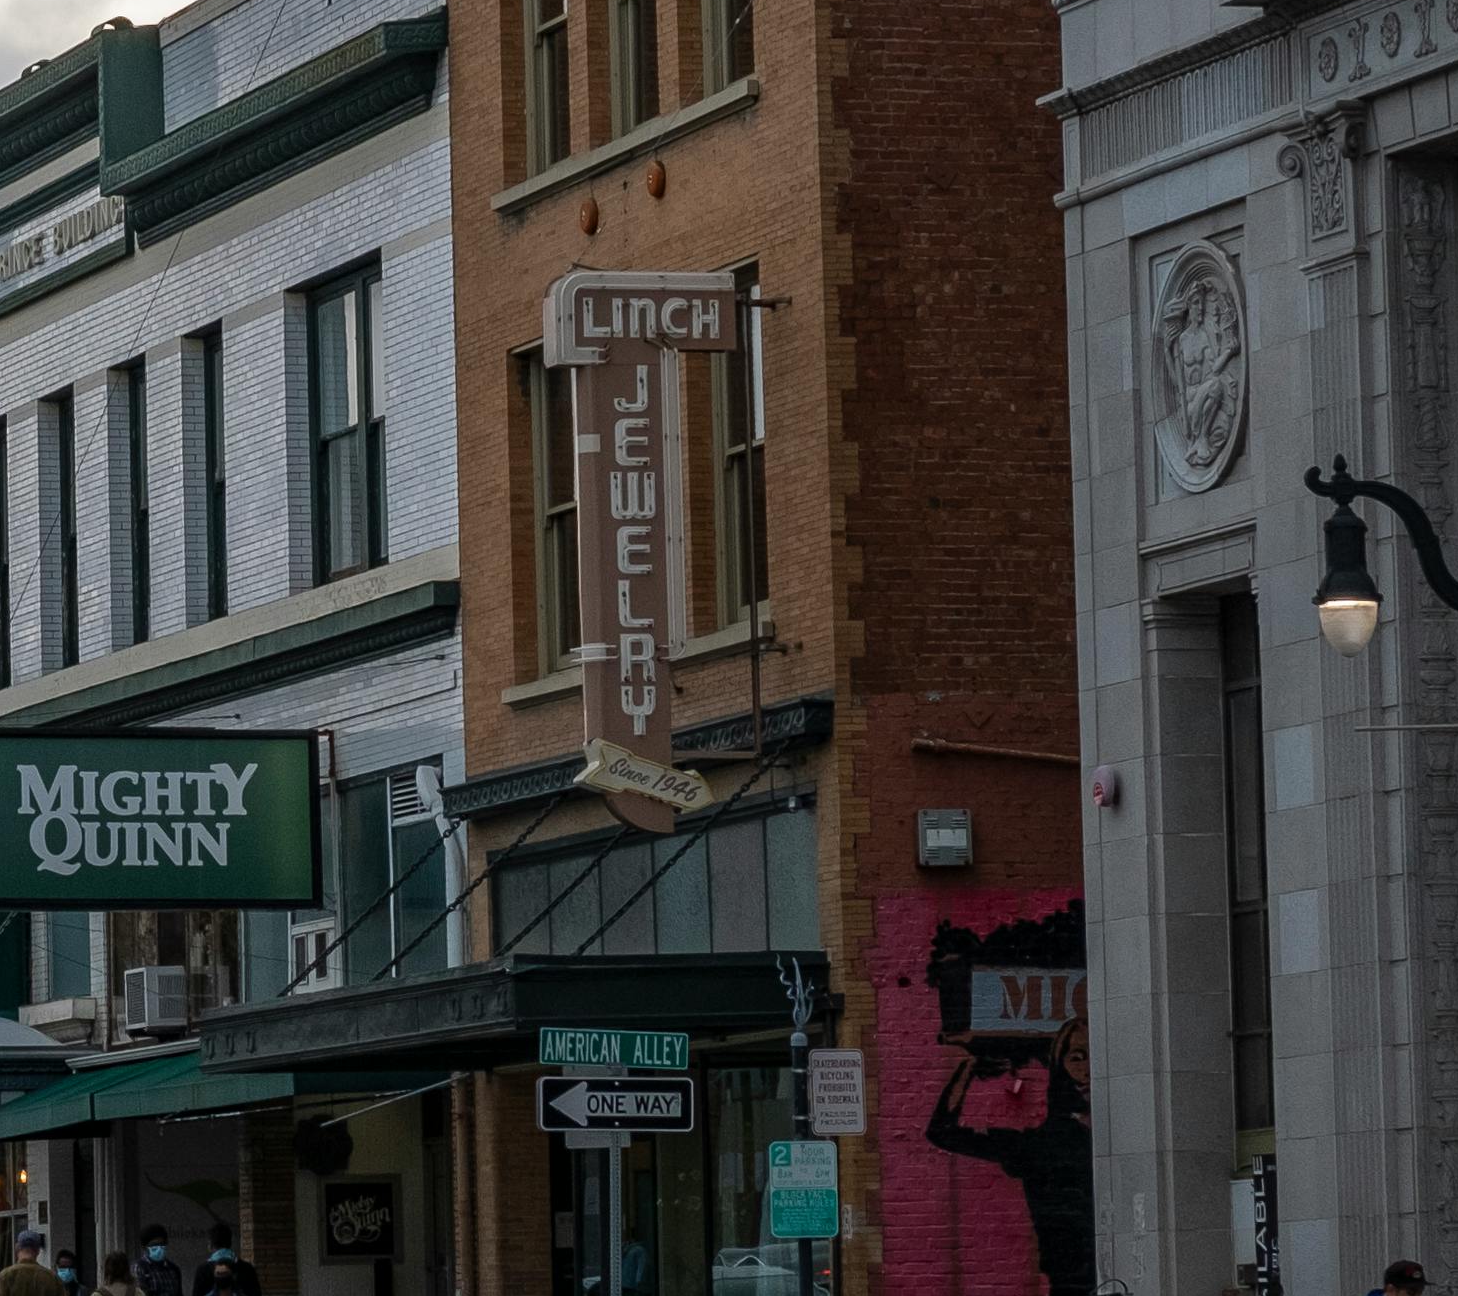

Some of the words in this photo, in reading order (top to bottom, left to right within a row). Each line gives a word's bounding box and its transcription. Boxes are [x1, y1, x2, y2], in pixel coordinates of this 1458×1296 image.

[52, 195, 125, 256] BUILDING
[582, 297, 720, 340] LINCH
[610, 365, 657, 736] JEWELRY
[16, 762, 259, 817] MIGHTY
[608, 758, 652, 786] Since
[653, 771, 701, 804] 1946
[29, 810, 232, 876] QUINN
[544, 1031, 621, 1063] AMERICAN
[633, 1035, 684, 1066] ALLEY
[818, 1083, 857, 1092] PROHIBITED
[820, 1071, 855, 1080] BICYCLING
[587, 1094, 627, 1114] ONE
[635, 1095, 675, 1114] WAY
[828, 1095, 860, 1104] SIDEWALK
[774, 1145, 789, 1165] 2
[794, 1156, 832, 1165] PARKING
